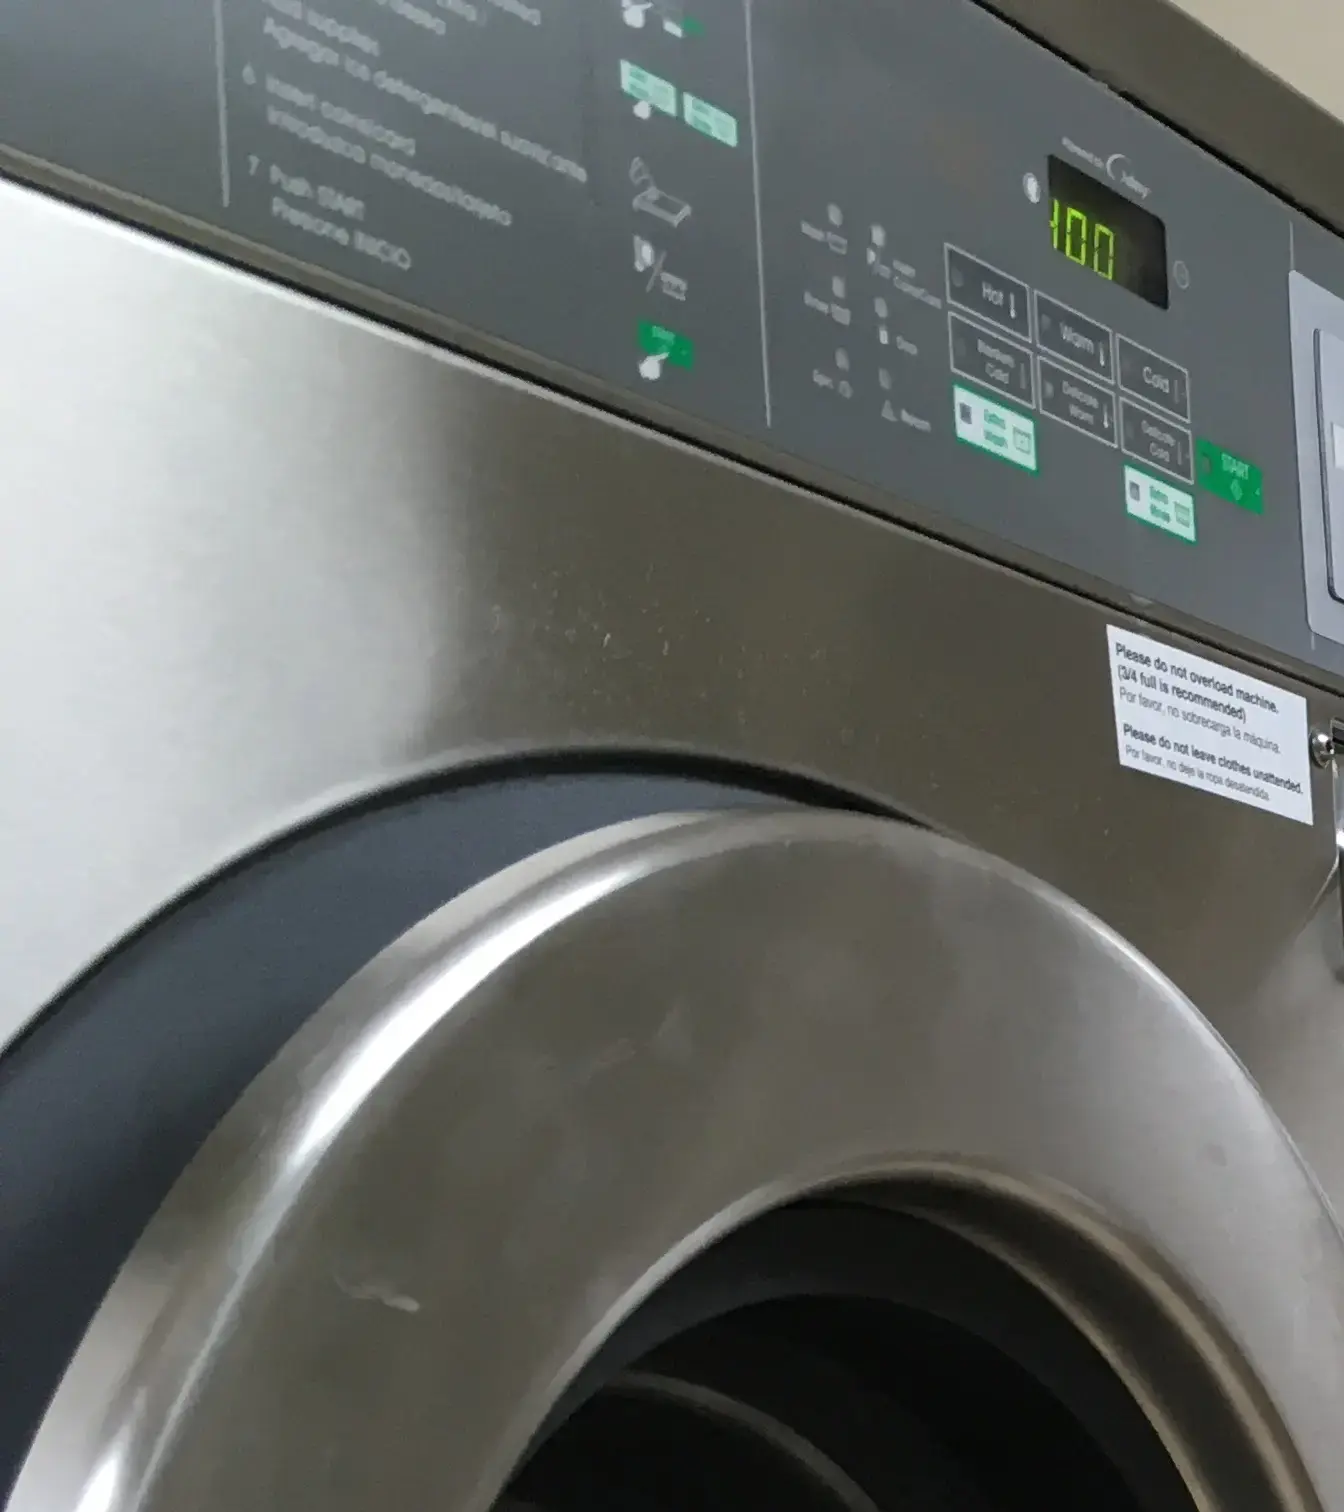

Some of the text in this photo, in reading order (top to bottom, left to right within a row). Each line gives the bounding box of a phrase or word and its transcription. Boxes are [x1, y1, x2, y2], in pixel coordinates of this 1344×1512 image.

[1049, 199, 1114, 280] 100
[1115, 642, 1152, 667] Please
[1154, 656, 1168, 673] do
[1170, 664, 1188, 680] not
[1190, 671, 1235, 697] overload
[1118, 665, 1247, 725] (3/4 full is recommended)
[1119, 686, 1136, 703] Por
[1167, 705, 1180, 718] no
[1182, 706, 1231, 738] sobrecarga
[1233, 725, 1241, 740] la
[1123, 723, 1157, 745] Please
[1158, 734, 1172, 749] do
[1173, 741, 1189, 757] not
[1192, 744, 1218, 764] leave
[1218, 755, 1251, 776] clothes
